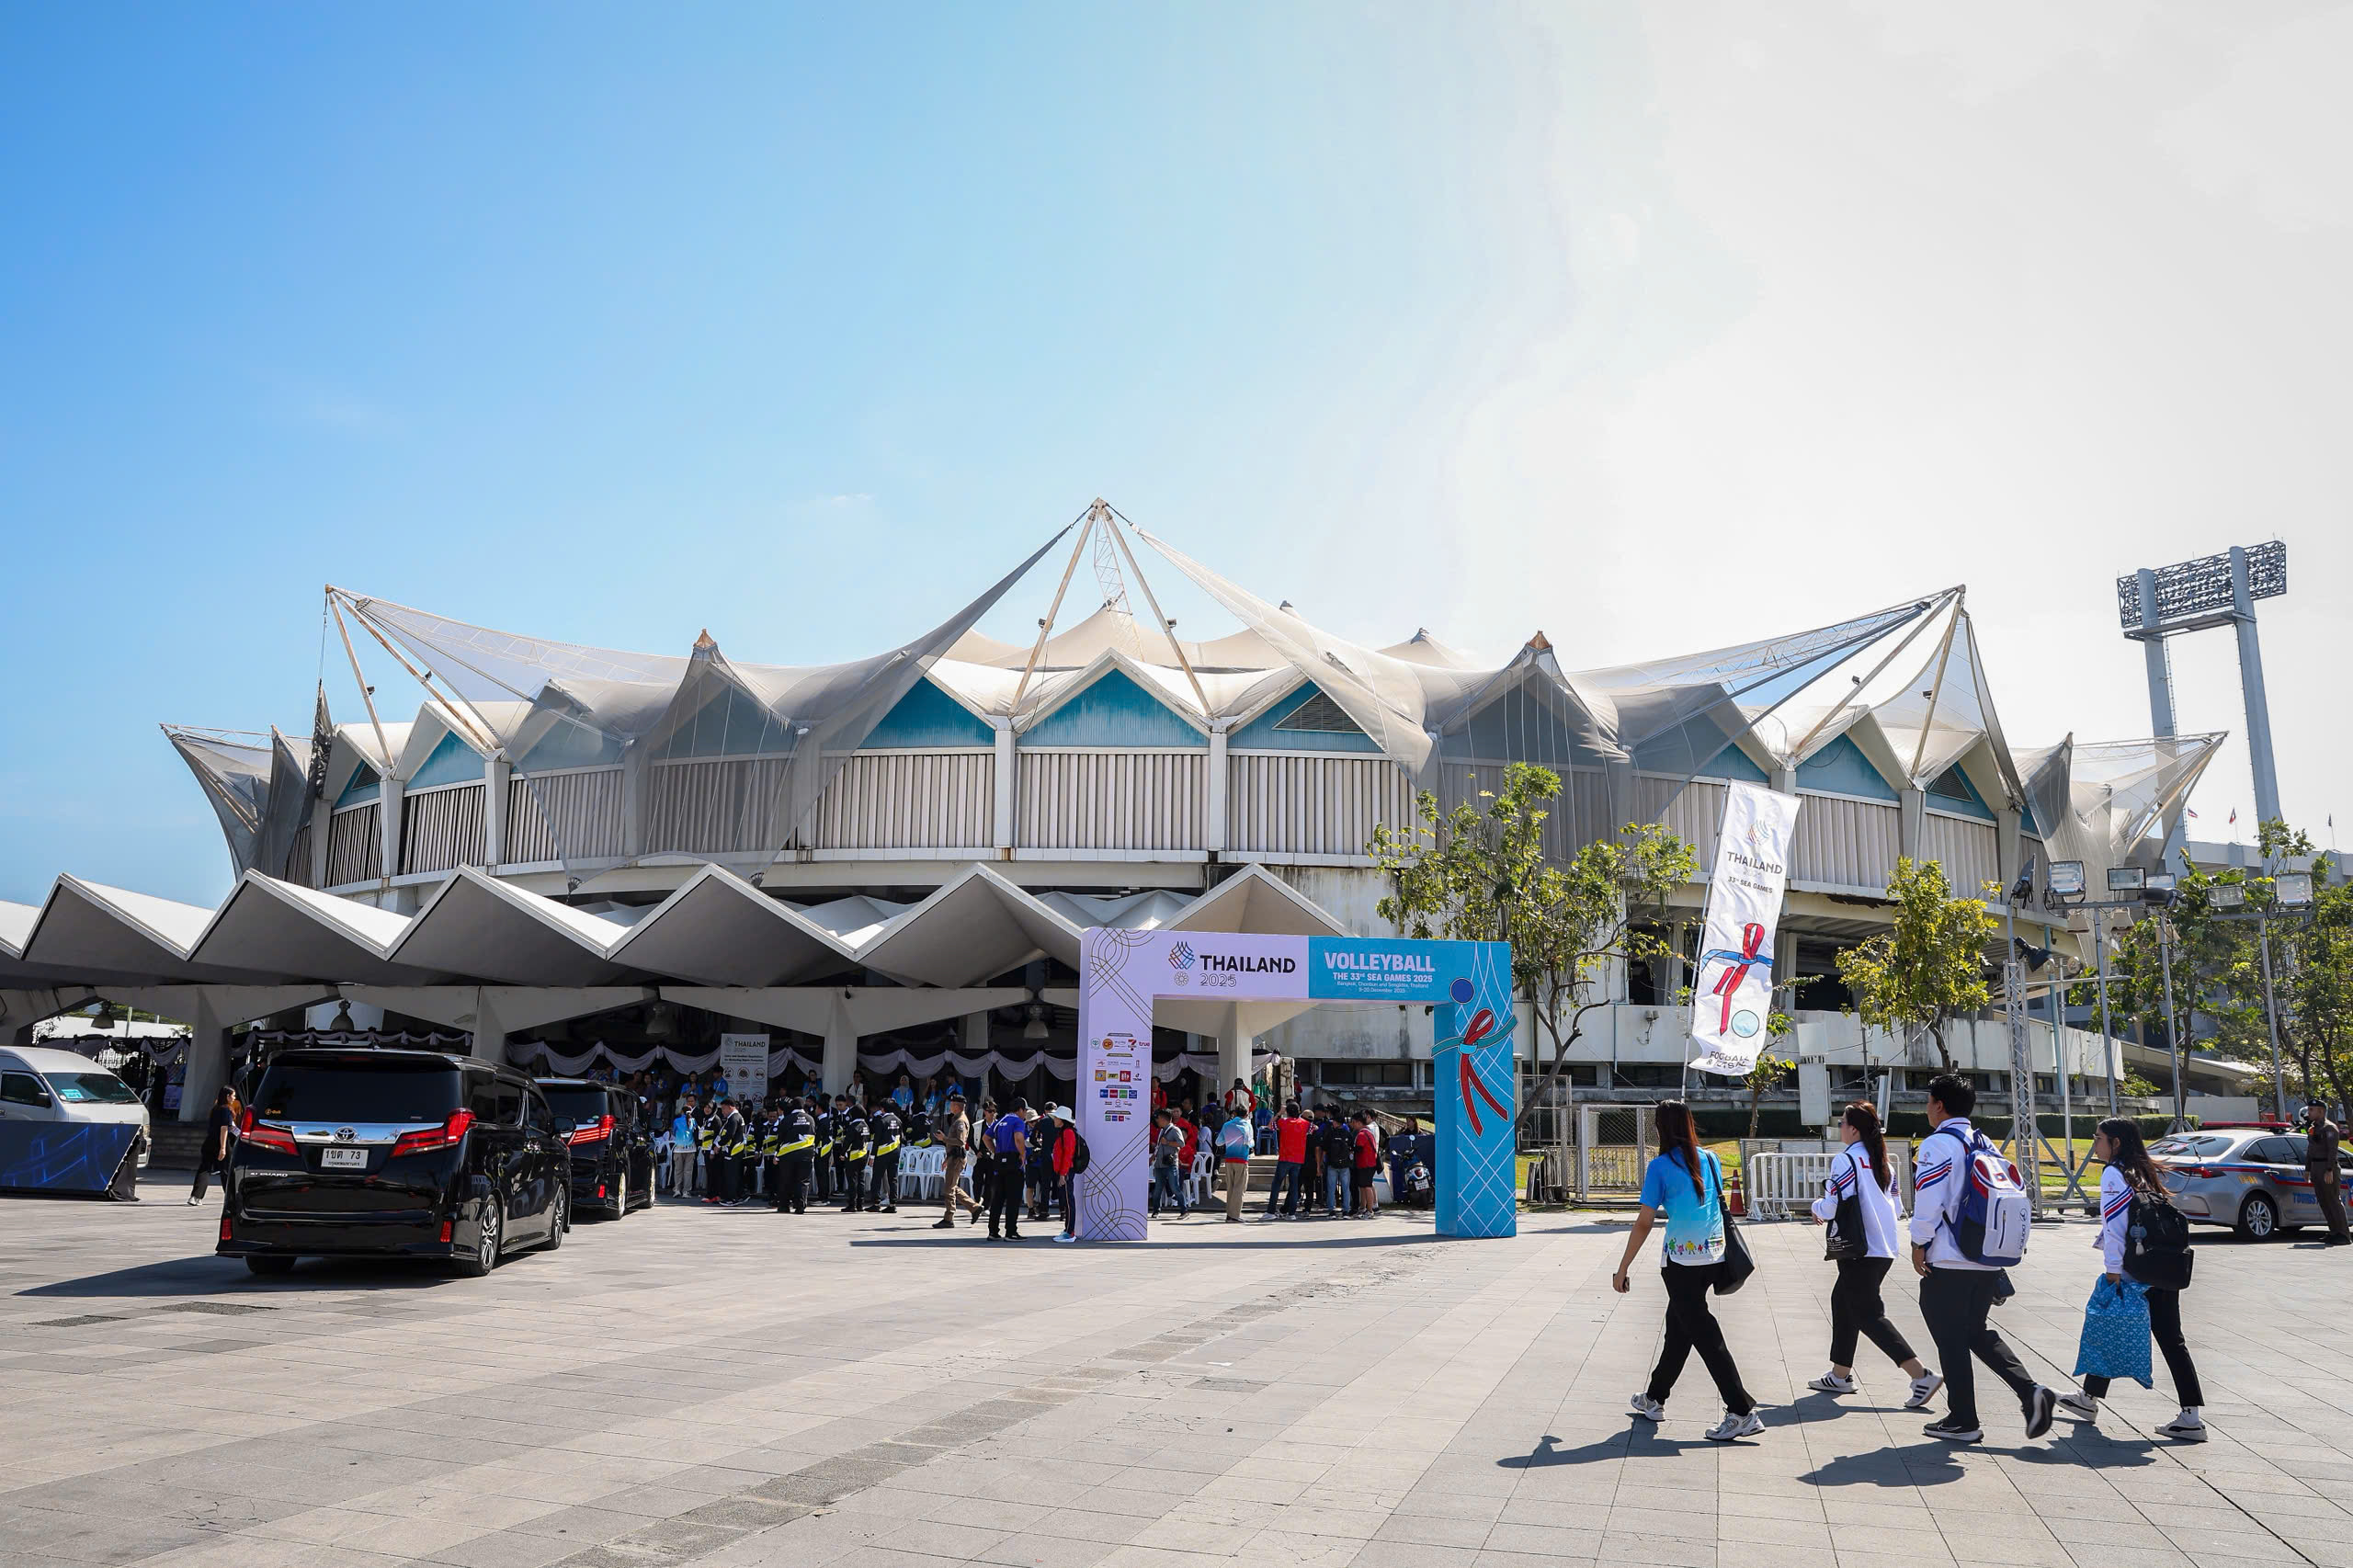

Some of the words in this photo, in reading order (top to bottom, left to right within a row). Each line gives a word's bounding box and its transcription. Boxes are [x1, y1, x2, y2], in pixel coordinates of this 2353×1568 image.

[1727, 851, 1783, 874] THAILAND
[1740, 880, 1751, 888] SEA
[1753, 883, 1773, 893] GAMES
[1199, 955, 1296, 973] THAILAND
[1324, 952, 1436, 972] VOLLEYBALL
[1199, 973, 1237, 987] 2025
[1384, 974, 1411, 982] GAMES
[350, 1151, 361, 1159] 73
